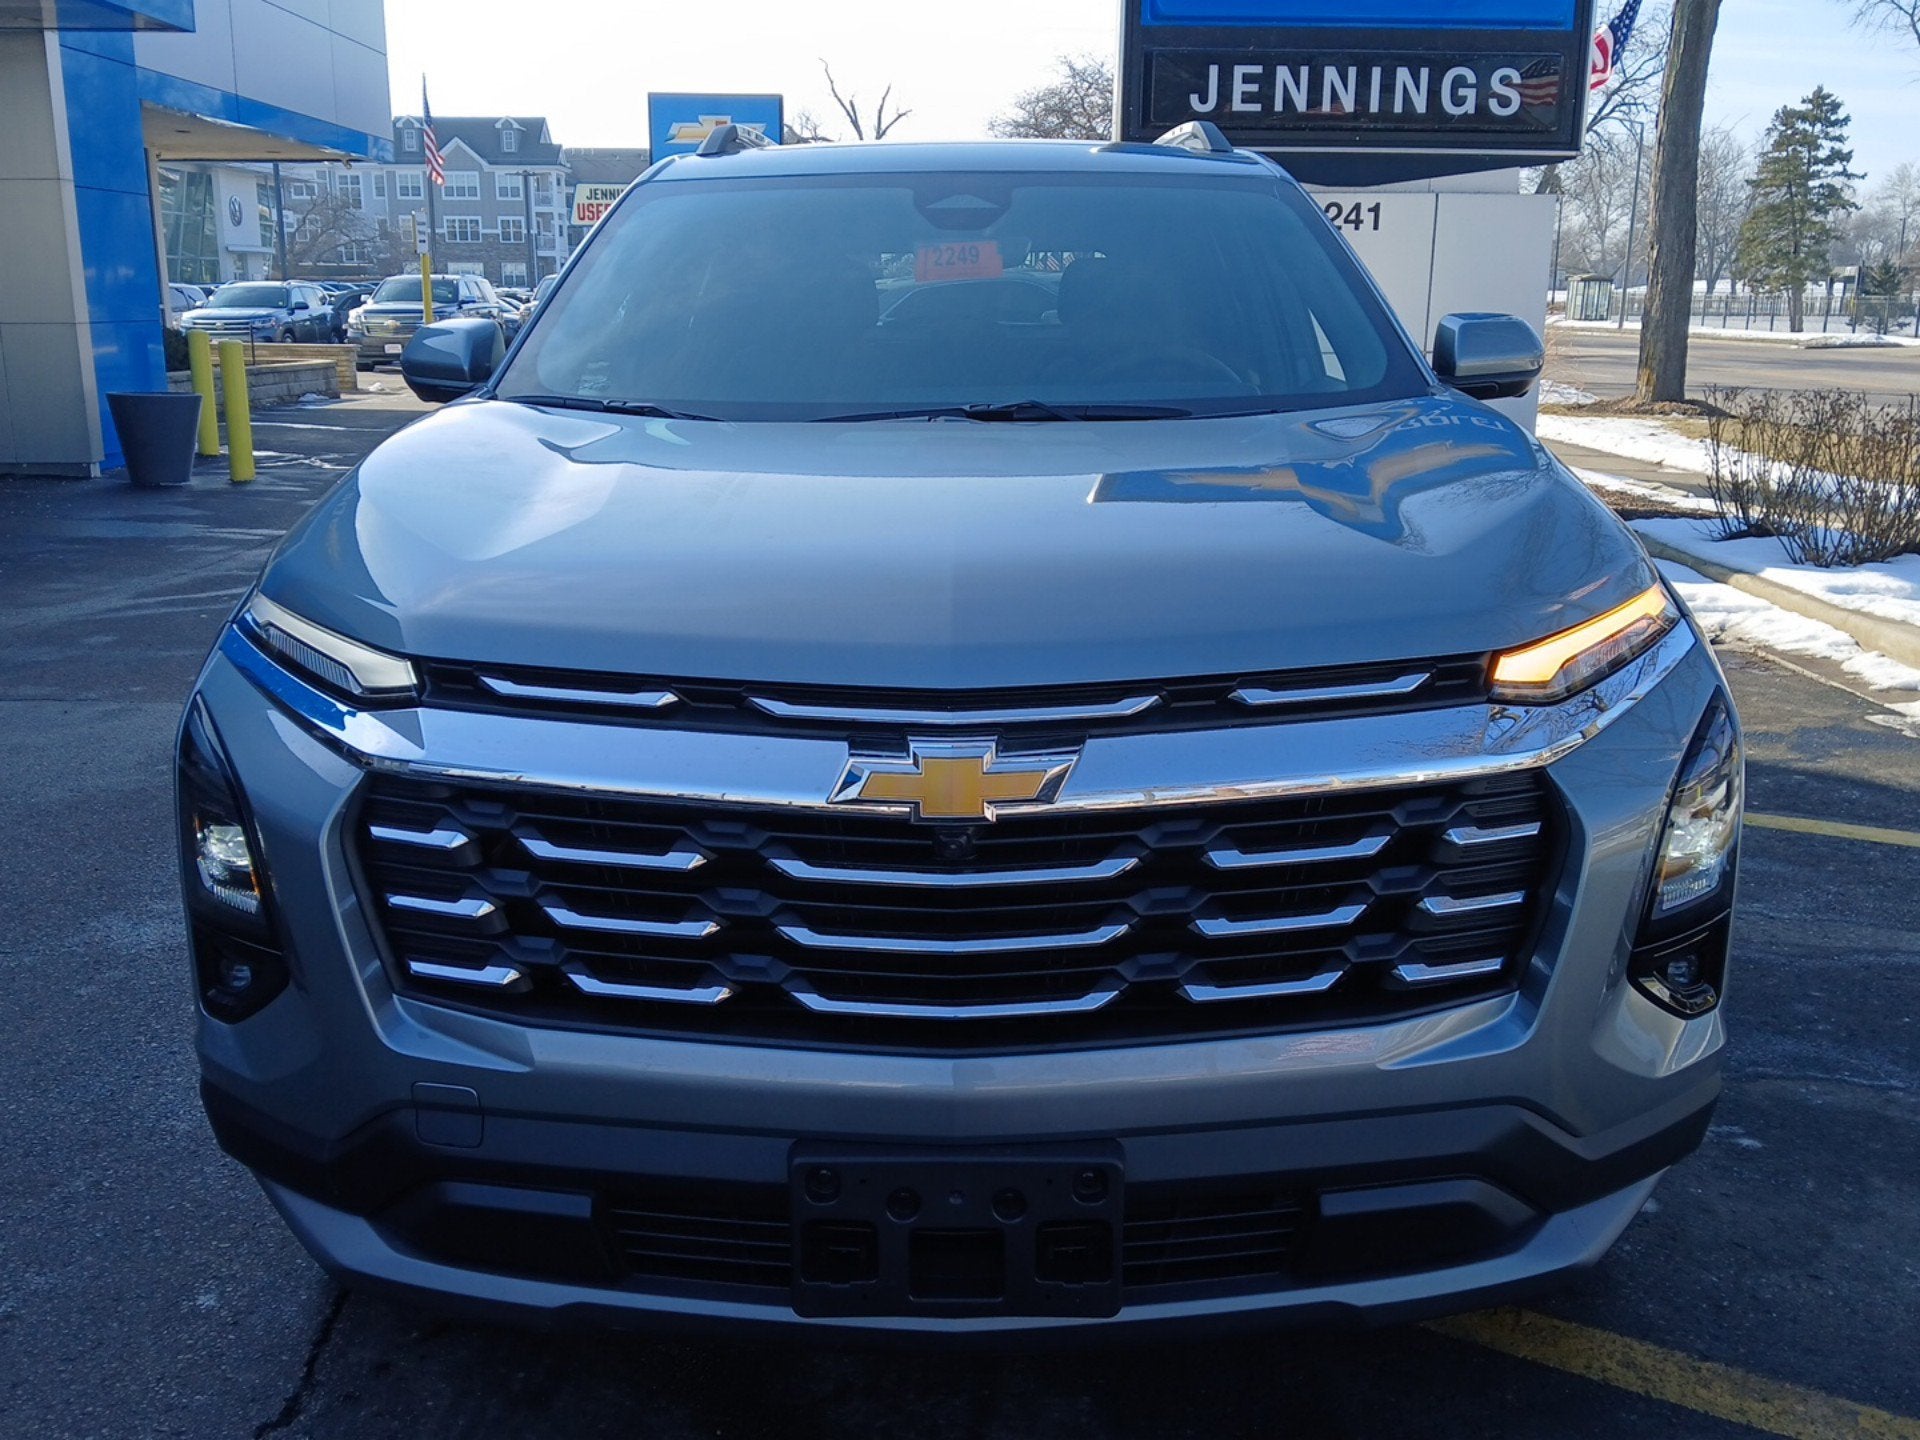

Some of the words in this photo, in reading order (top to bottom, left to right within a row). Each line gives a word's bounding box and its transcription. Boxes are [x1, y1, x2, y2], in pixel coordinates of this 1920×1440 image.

[1188, 63, 1523, 117] JENNINGS
[1324, 201, 1382, 231] 241
[933, 244, 980, 267] 2249
